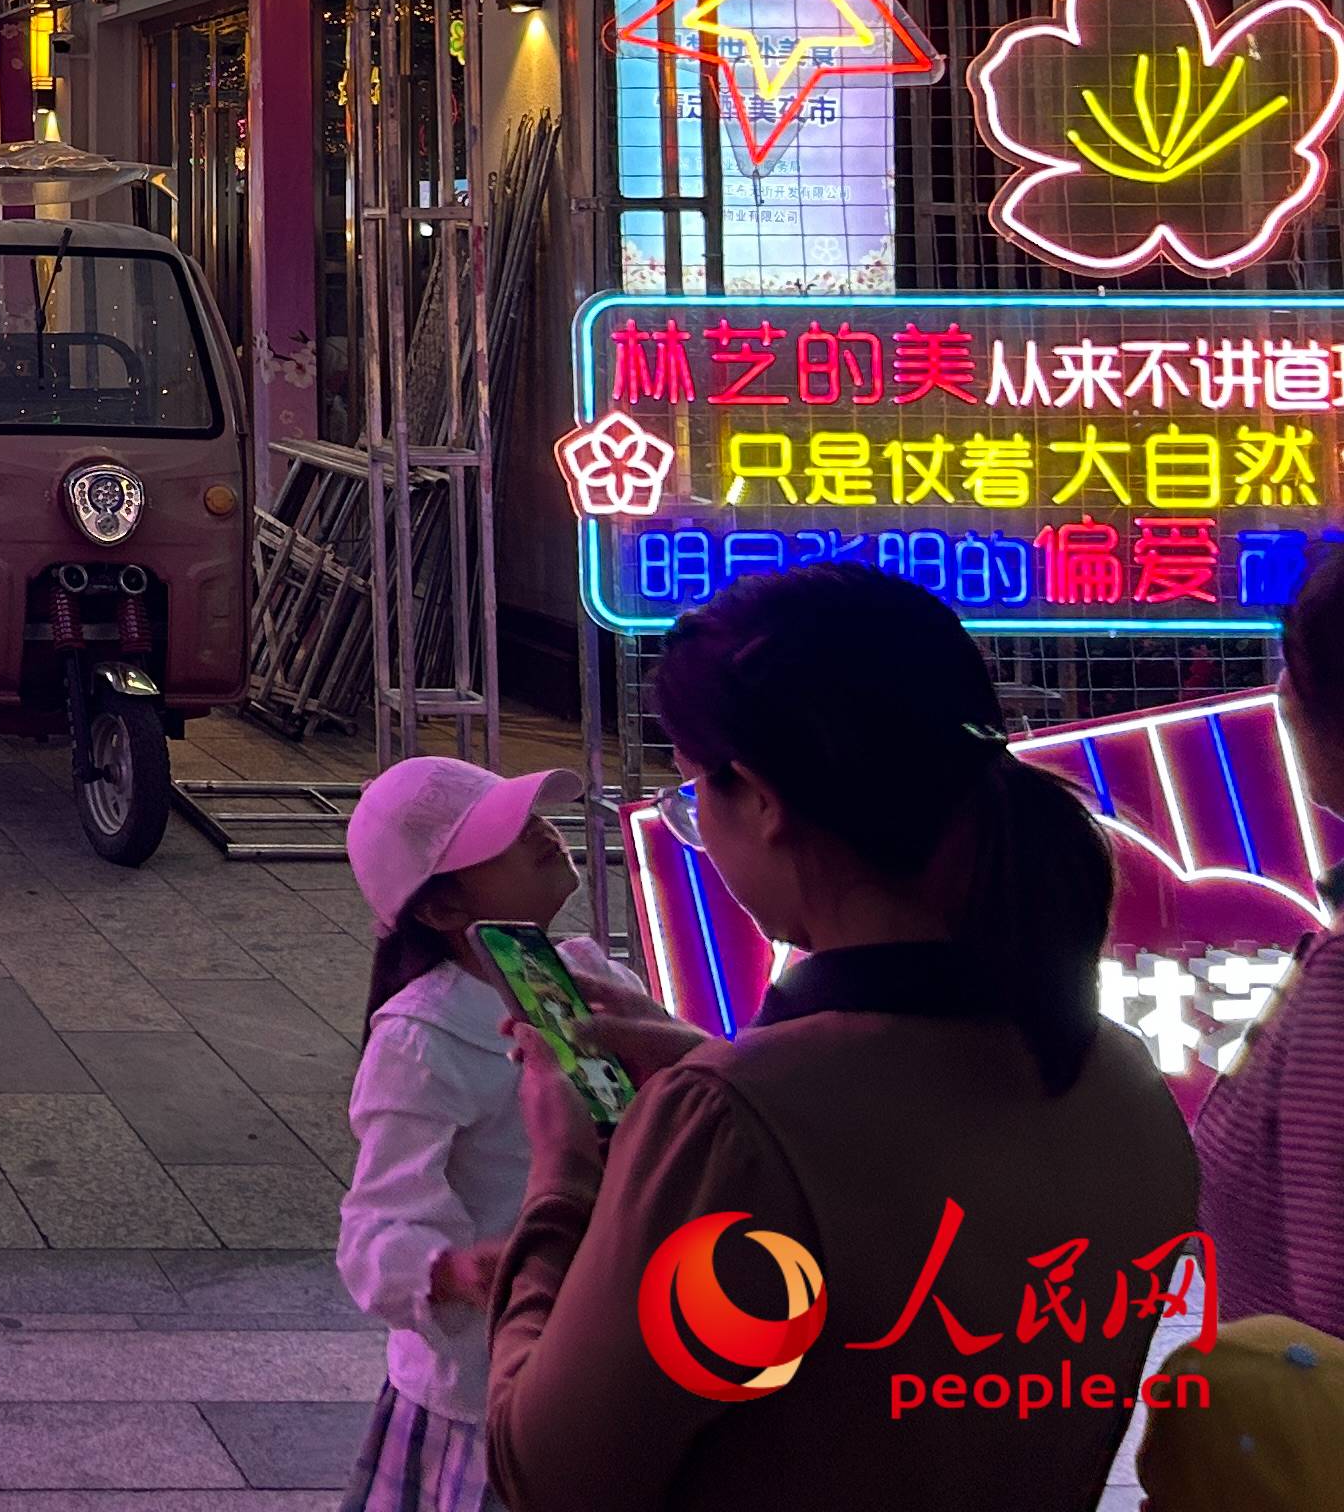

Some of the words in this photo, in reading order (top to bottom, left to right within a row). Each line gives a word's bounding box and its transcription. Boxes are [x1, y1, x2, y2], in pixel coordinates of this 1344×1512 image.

[723, 424, 1320, 509] 只是仗着大自然
